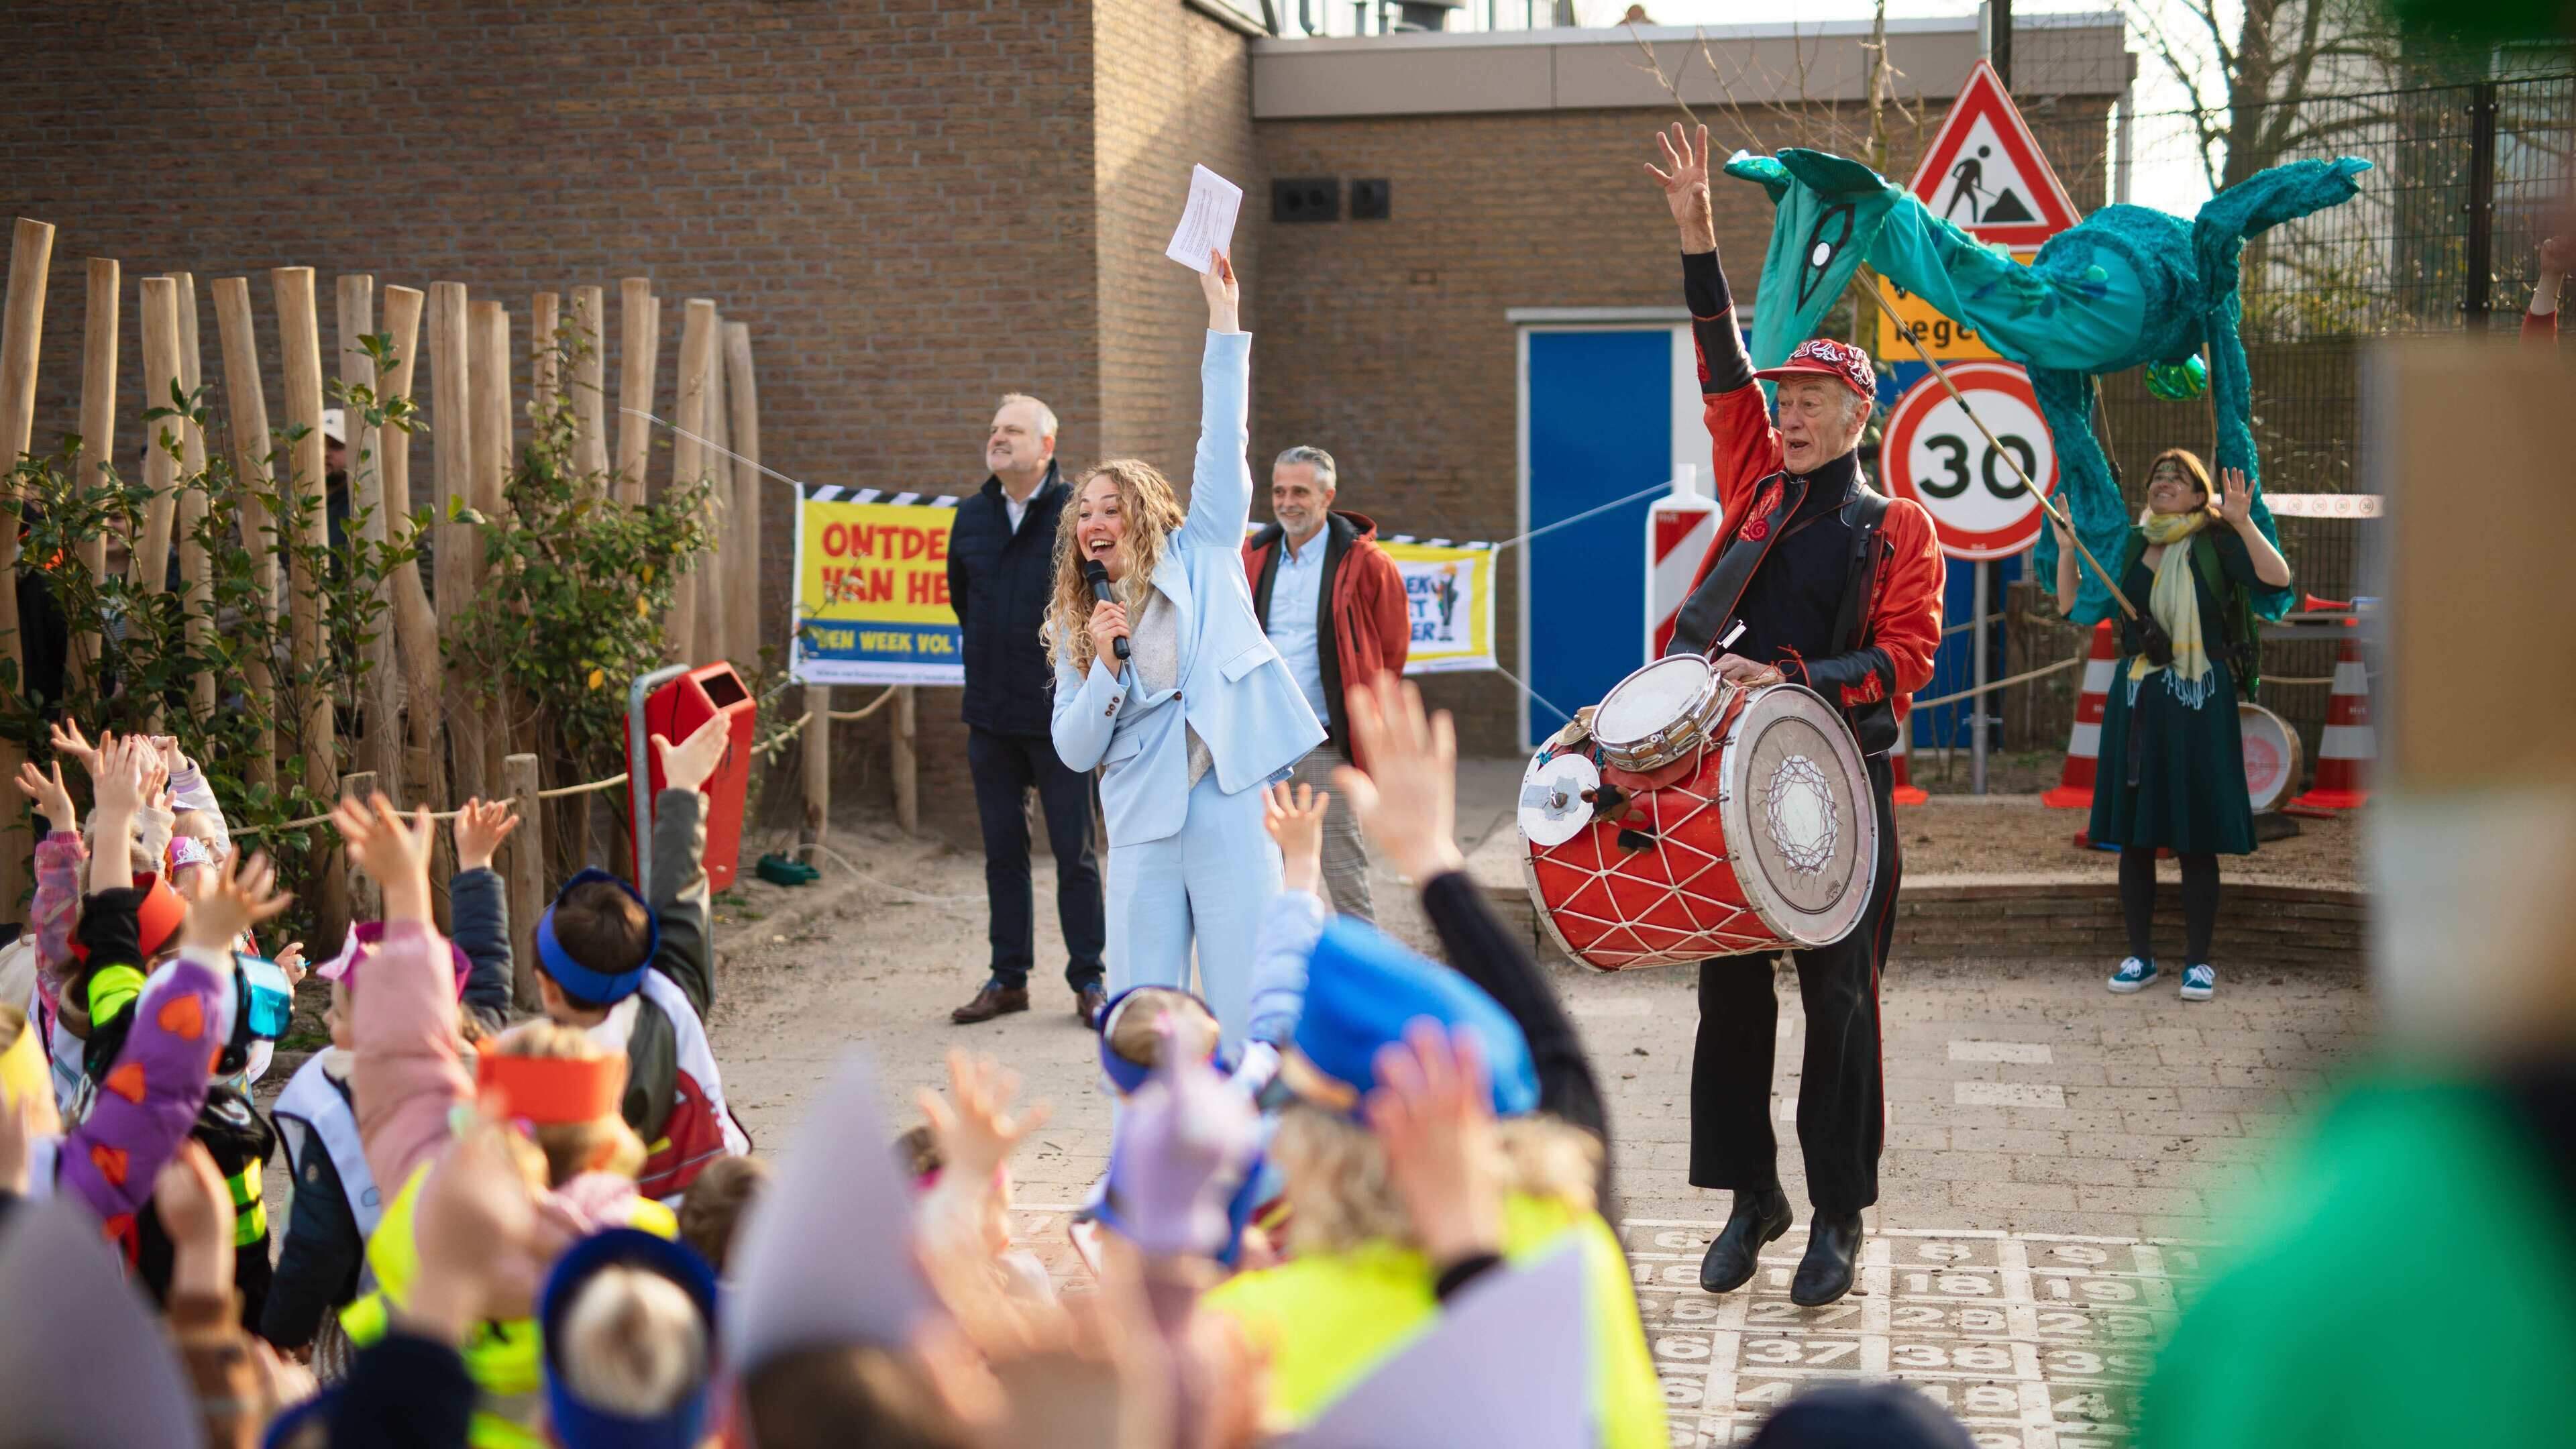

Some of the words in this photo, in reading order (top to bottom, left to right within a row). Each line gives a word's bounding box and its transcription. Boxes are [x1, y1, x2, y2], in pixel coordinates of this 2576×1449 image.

[1919, 433, 2037, 500] 30
[822, 522, 947, 561] ONTDE
[820, 566, 894, 602] VAN
[906, 570, 951, 606] HE
[1406, 574, 1431, 594] EK
[860, 631, 912, 651] WEEK
[917, 633, 954, 655] VOL
[1411, 622, 1436, 641] ER
[1918, 1242, 1972, 1261] 8
[2054, 1244, 2108, 1265] 9
[1630, 1263, 1702, 1284] 16
[1769, 1268, 1791, 1287] 1
[1904, 1273, 1994, 1294] 18
[2044, 1278, 2137, 1301] 19
[1747, 1301, 1862, 1325] 27
[1889, 1306, 2008, 1330] 28
[2037, 1312, 2153, 1337] 29
[1654, 1335, 1711, 1359] 6
[1744, 1338, 1861, 1364] 37
[1890, 1344, 2012, 1370] 38
[2046, 1350, 2157, 1377] 39
[1735, 1382, 1794, 1408] 4
